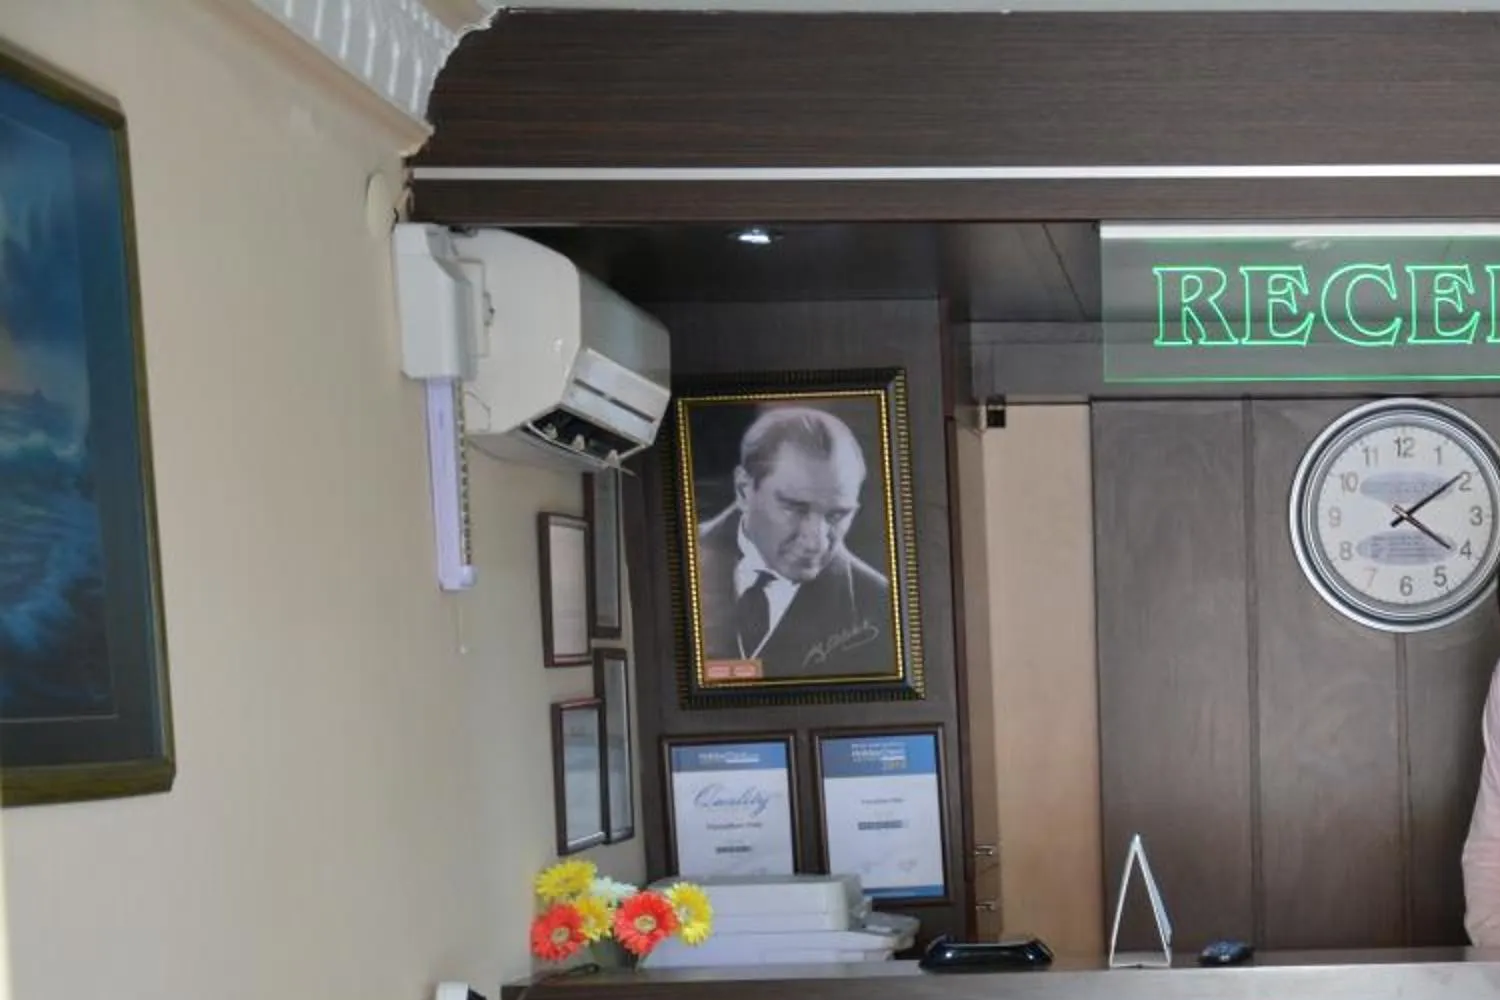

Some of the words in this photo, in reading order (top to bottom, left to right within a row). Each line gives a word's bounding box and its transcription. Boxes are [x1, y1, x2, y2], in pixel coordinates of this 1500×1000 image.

[1362, 448, 1379, 466] 11
[1394, 437, 1415, 458] 12
[1435, 446, 1443, 465] 1
[1340, 472, 1359, 493] 10
[1458, 471, 1472, 492] 2
[1328, 507, 1342, 527] 9
[1469, 506, 1483, 526] 3
[1339, 541, 1353, 561] 8
[1459, 539, 1473, 560] 4
[1363, 568, 1377, 588] 7
[1399, 576, 1414, 597] 6
[1433, 566, 1448, 587] 5
